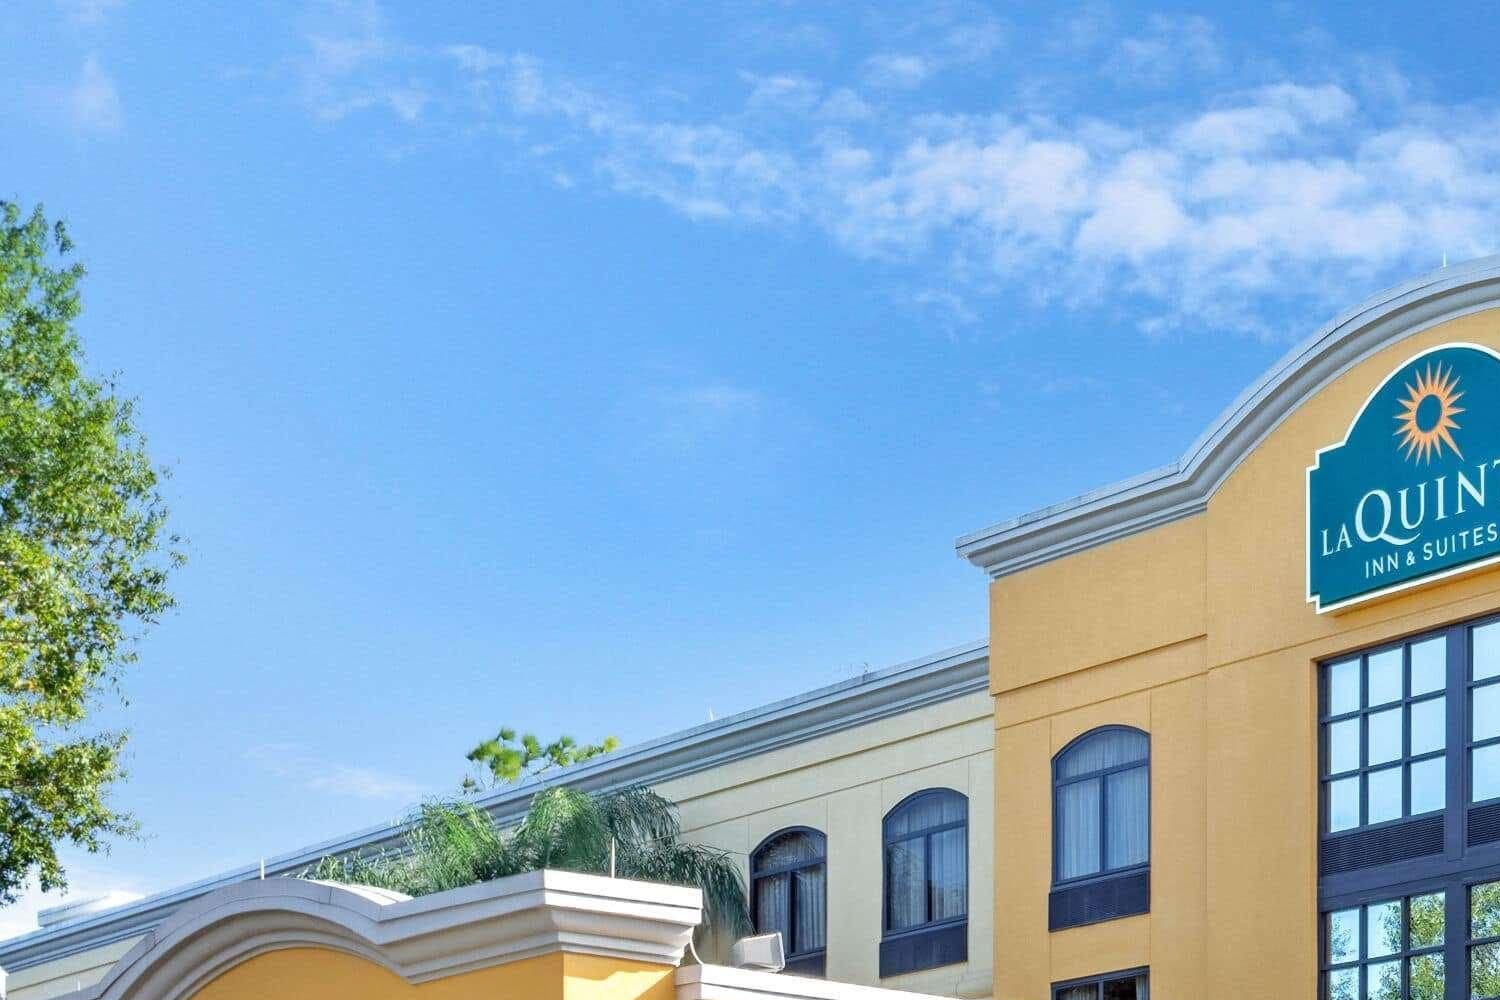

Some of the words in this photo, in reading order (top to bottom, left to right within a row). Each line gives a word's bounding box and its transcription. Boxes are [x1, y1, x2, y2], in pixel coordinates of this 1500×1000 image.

[1365, 552, 1399, 579] INN
[1406, 550, 1416, 566] &
[1423, 522, 1498, 561] SUITES
